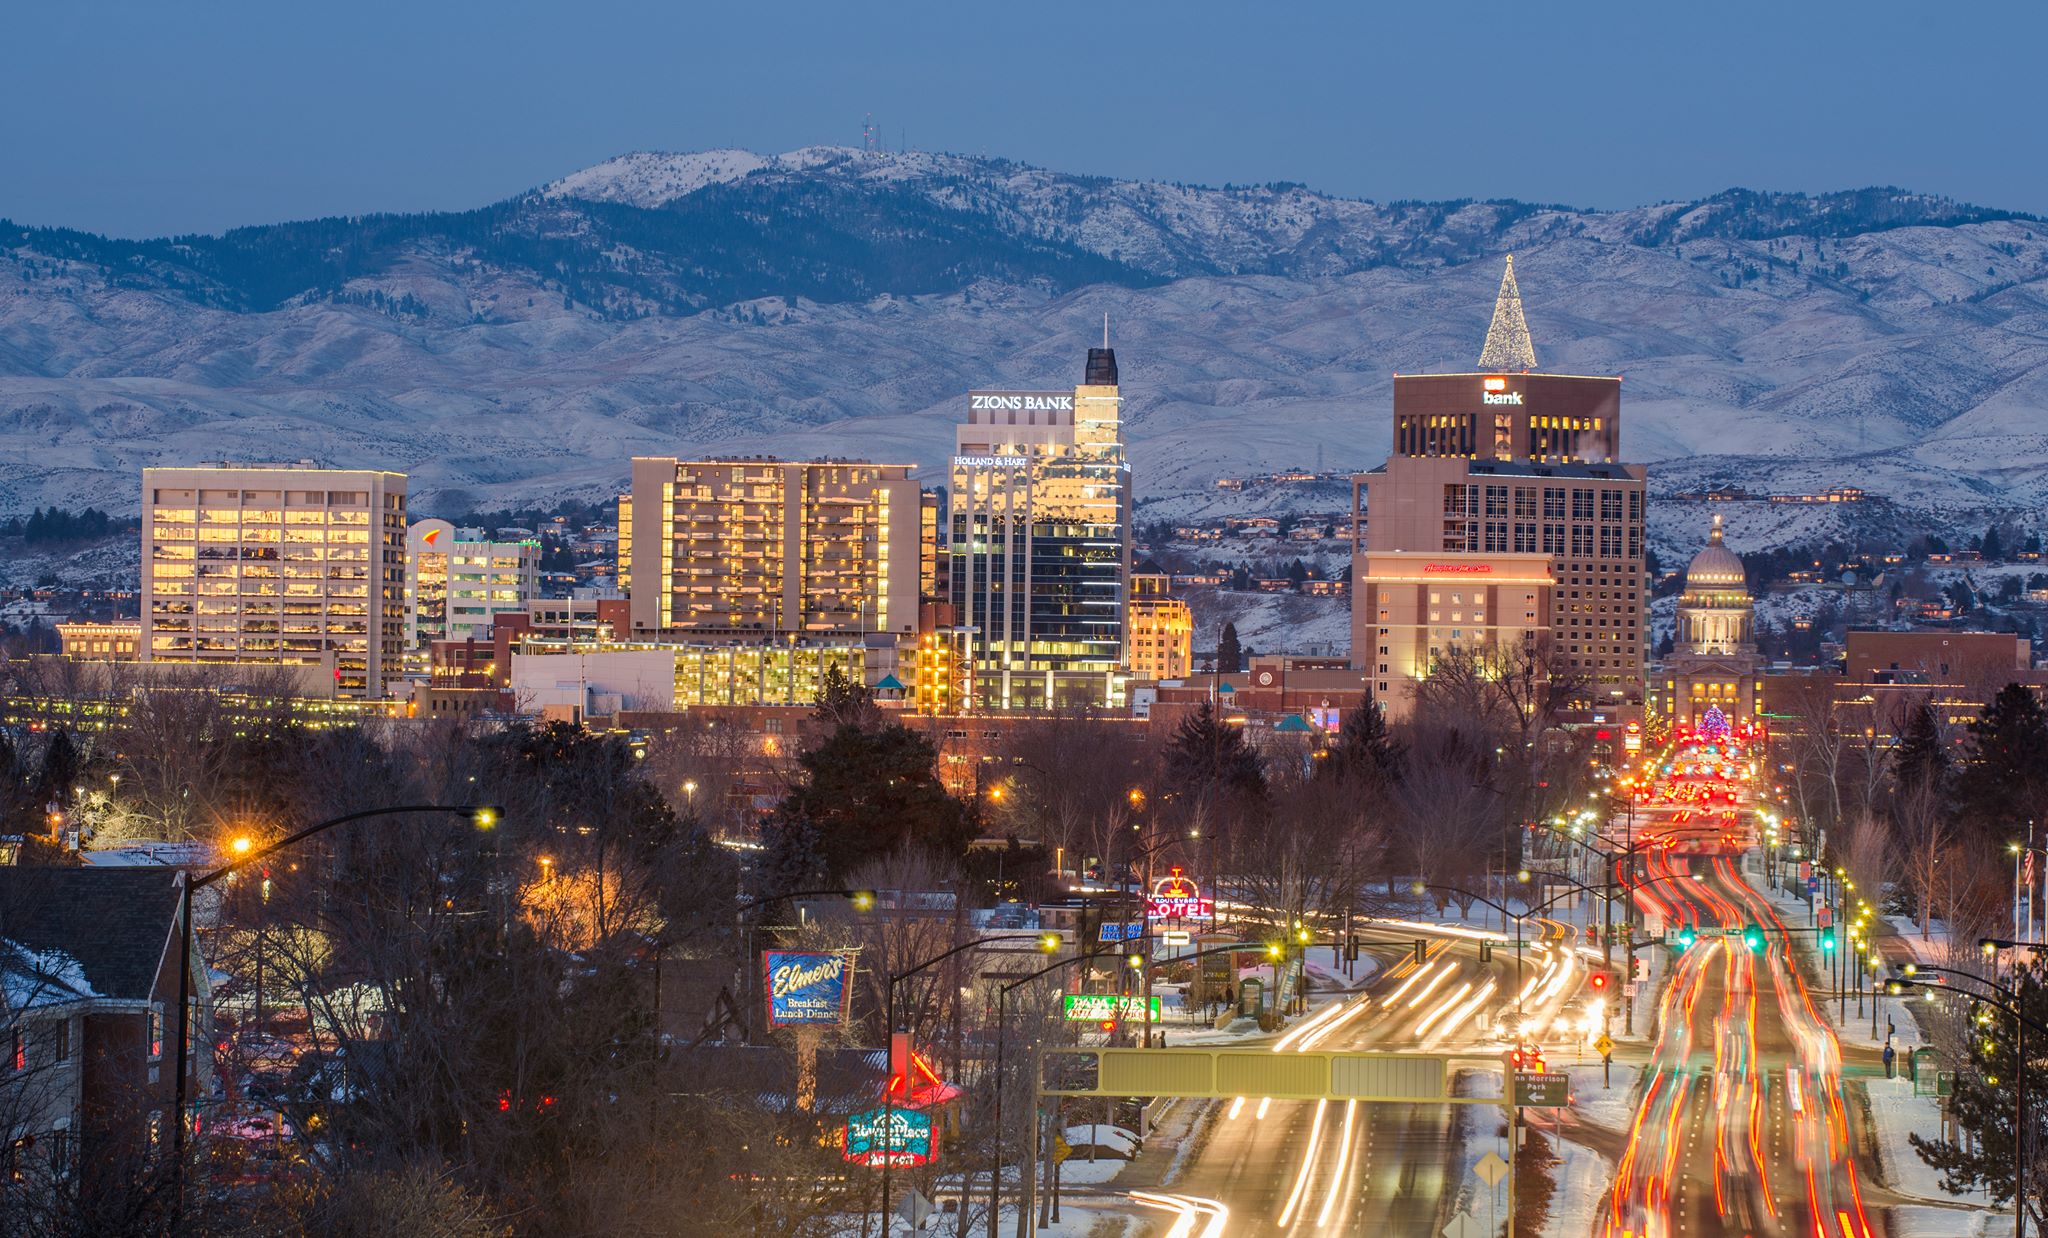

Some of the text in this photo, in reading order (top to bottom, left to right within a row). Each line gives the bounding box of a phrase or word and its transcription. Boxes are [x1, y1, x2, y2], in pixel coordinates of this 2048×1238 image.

[971, 395, 1074, 411] ZIONS BANK
[1483, 391, 1523, 405] bank
[994, 457, 1004, 466] &
[773, 958, 843, 998] Elmer's
[787, 998, 828, 1009] Breakfast
